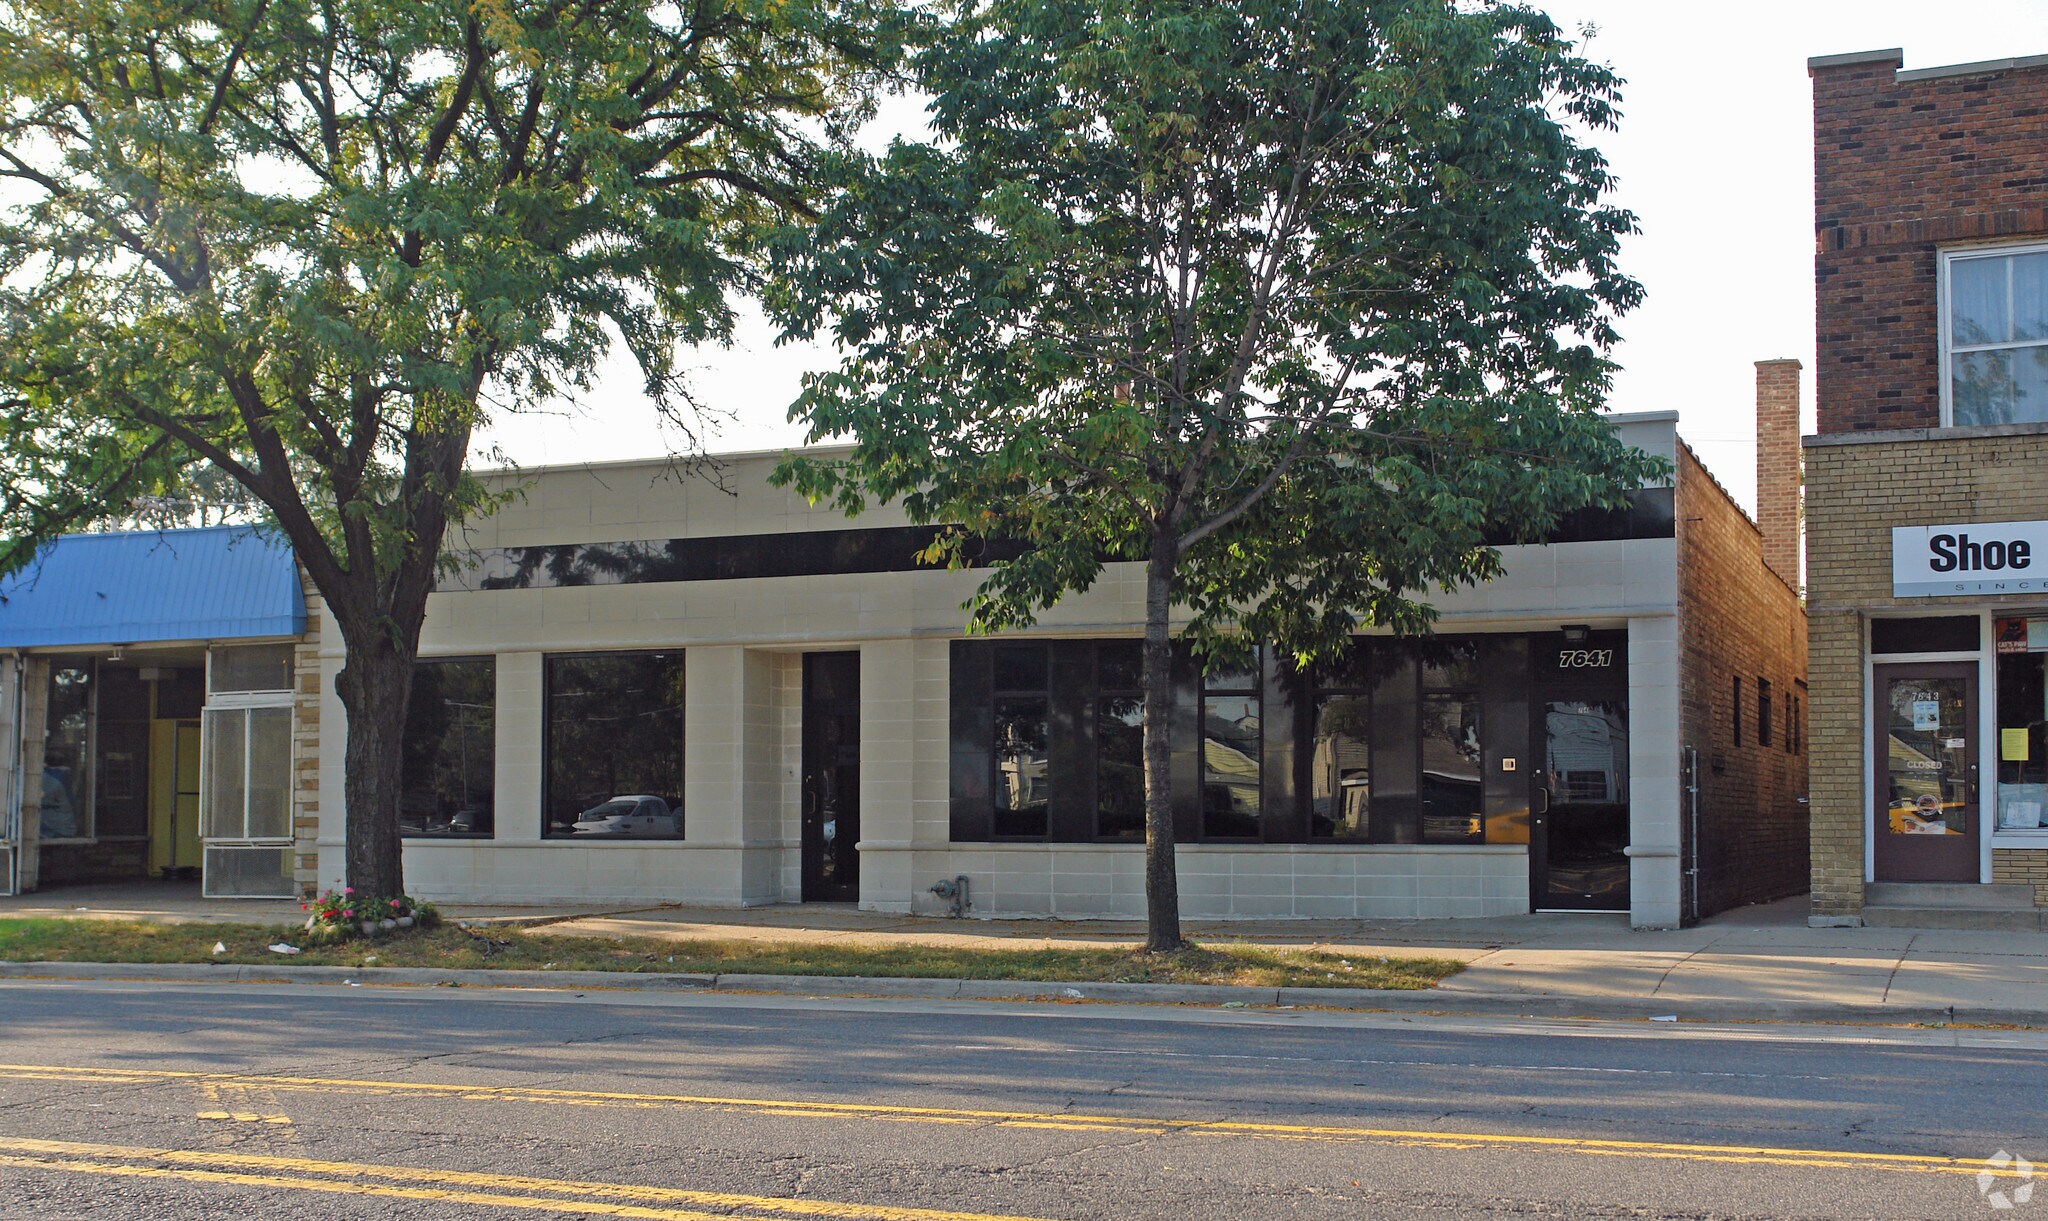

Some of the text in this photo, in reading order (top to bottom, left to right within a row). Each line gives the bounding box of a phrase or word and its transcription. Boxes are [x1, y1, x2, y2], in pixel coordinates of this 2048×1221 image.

[1930, 534, 2030, 572] Shoe
[1560, 650, 1612, 667] 7641
[1911, 692, 1939, 700] 7643
[1907, 761, 1942, 769] CLOSED
